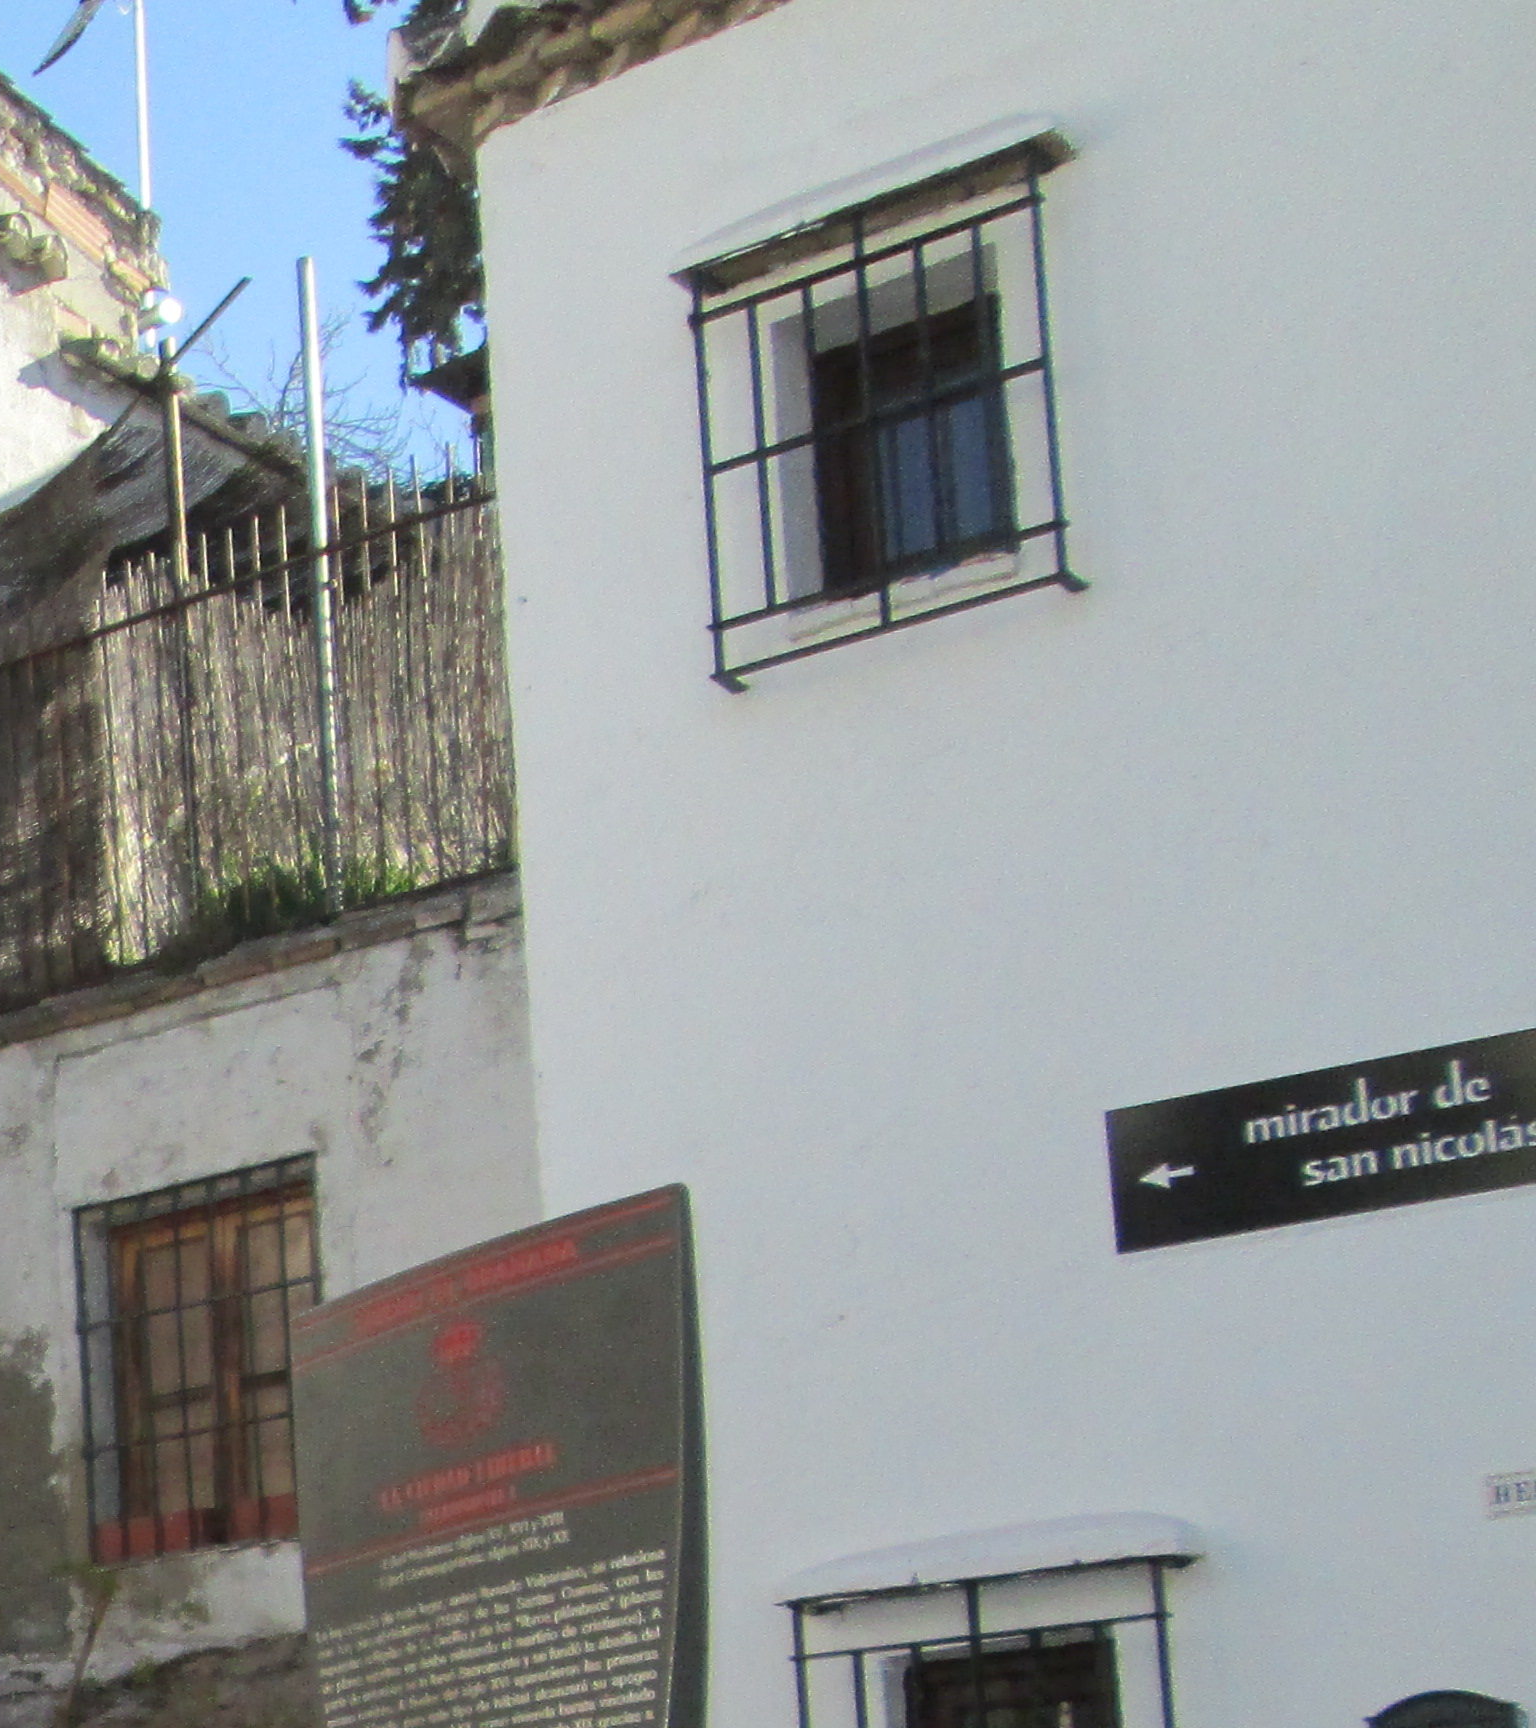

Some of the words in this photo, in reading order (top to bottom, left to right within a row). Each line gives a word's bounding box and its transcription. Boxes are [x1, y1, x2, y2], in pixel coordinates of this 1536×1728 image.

[1243, 1076, 1419, 1145] mirador
[1432, 1058, 1492, 1110] de
[1301, 1148, 1378, 1187] san
